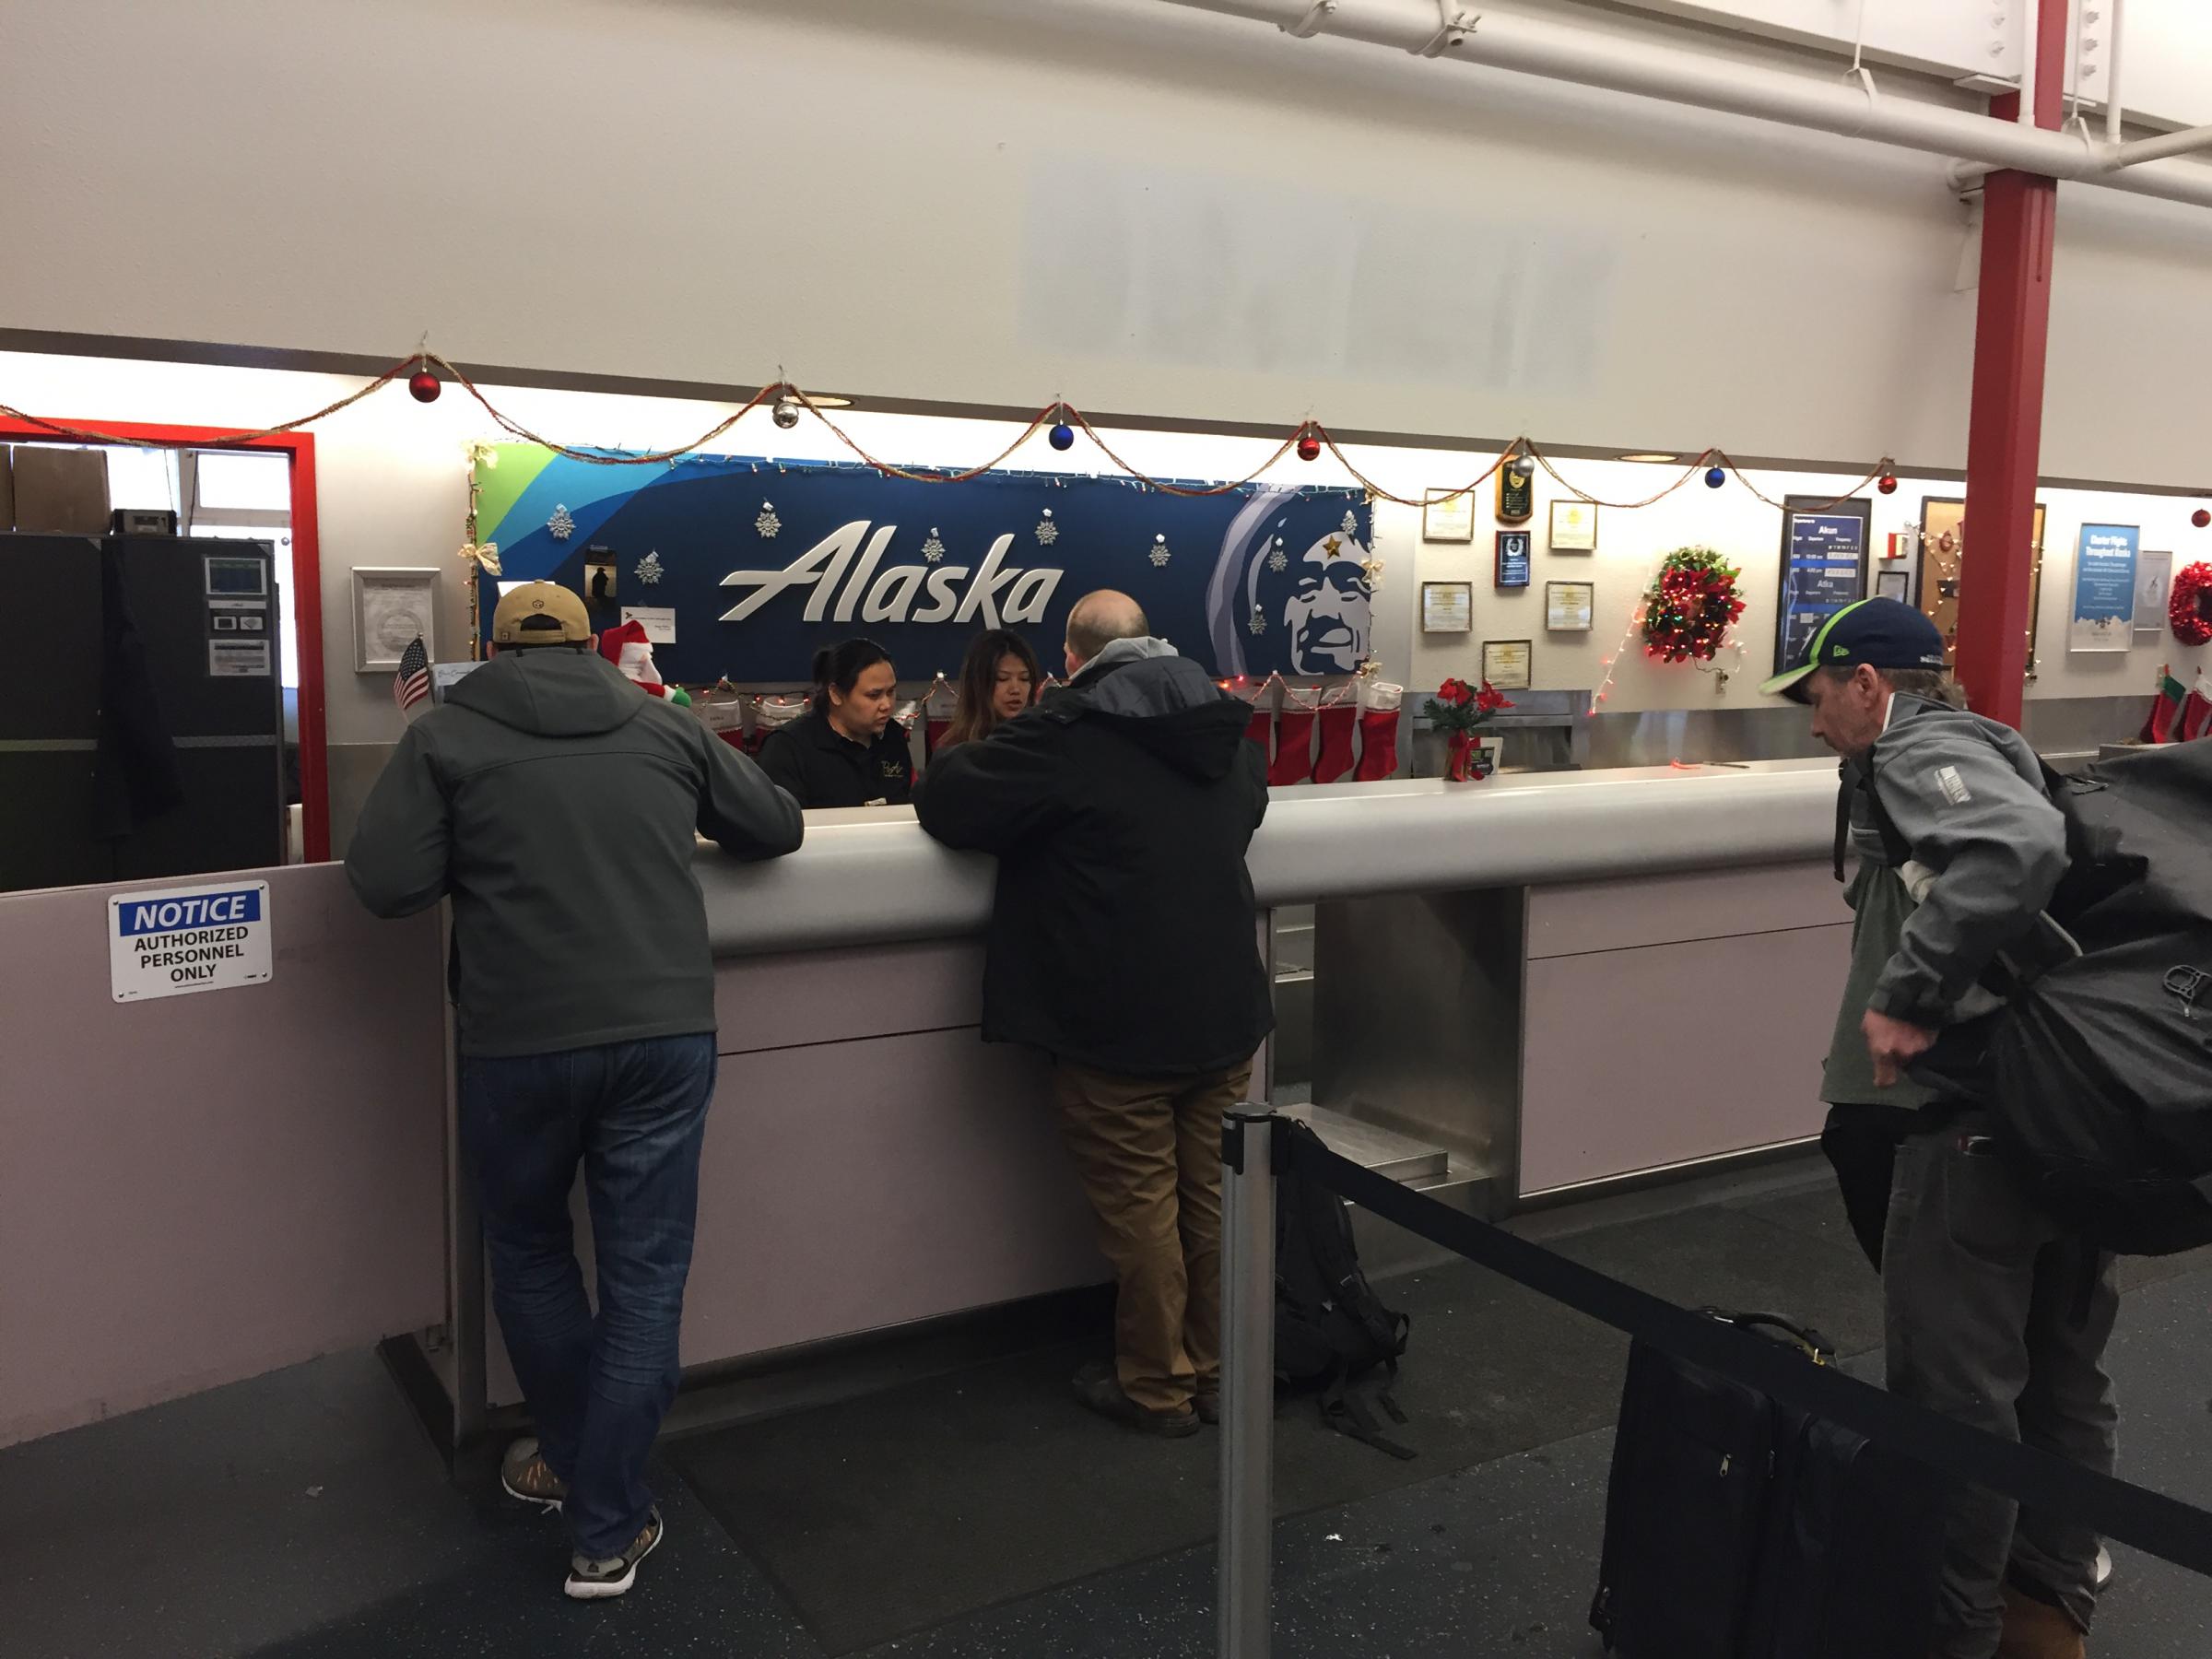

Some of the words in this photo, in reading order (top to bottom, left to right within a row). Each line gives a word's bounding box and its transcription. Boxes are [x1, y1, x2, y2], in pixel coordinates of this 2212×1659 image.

[718, 520, 1065, 630] Alaska
[134, 895, 246, 931] NOTICE
[134, 926, 249, 952] AUTHORIZED
[140, 944, 244, 969] PERSONNEL
[171, 964, 217, 982] ONLY
